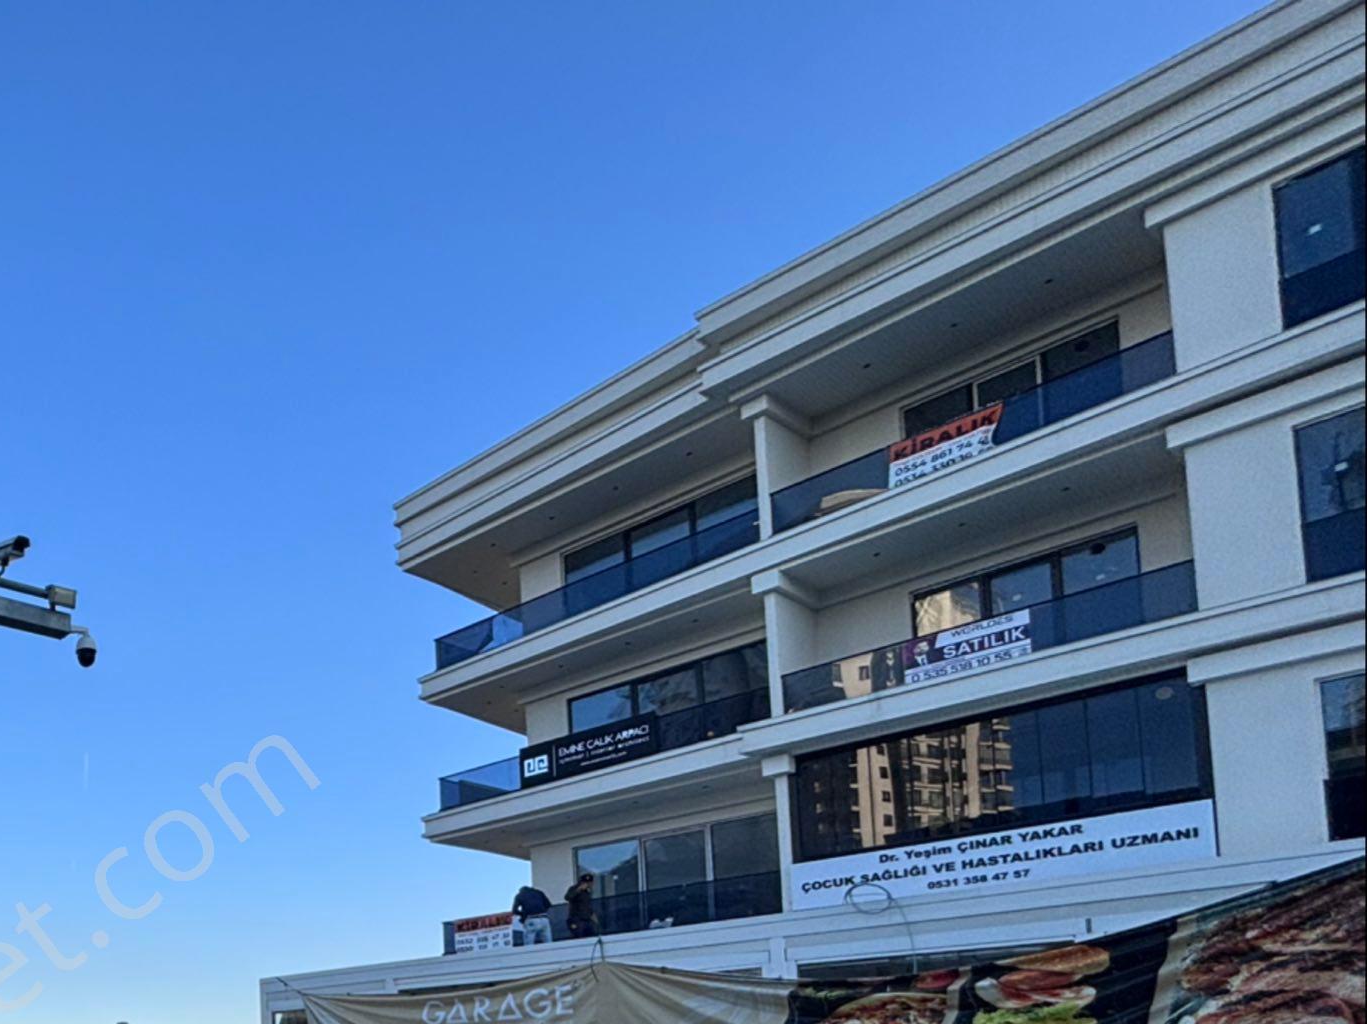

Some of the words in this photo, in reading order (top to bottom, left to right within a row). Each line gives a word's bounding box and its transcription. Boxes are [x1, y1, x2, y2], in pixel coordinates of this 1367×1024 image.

[943, 626, 1025, 661] SATILIK
[802, 875, 856, 894] ÇOCUK
[860, 863, 927, 884] SAĞLIĞI
[931, 860, 957, 874] VE
[961, 840, 1105, 871] HASTALIKLARI
[1111, 826, 1200, 850] UZMANI
[879, 853, 899, 863] Dr.
[904, 845, 952, 860] Yeşim
[957, 833, 1013, 854] ÇINAR
[1018, 823, 1084, 844] YAKAR
[927, 878, 960, 891] 0531
[963, 873, 988, 887] 358
[991, 871, 1010, 882] 47
[1013, 868, 1031, 879] 57
